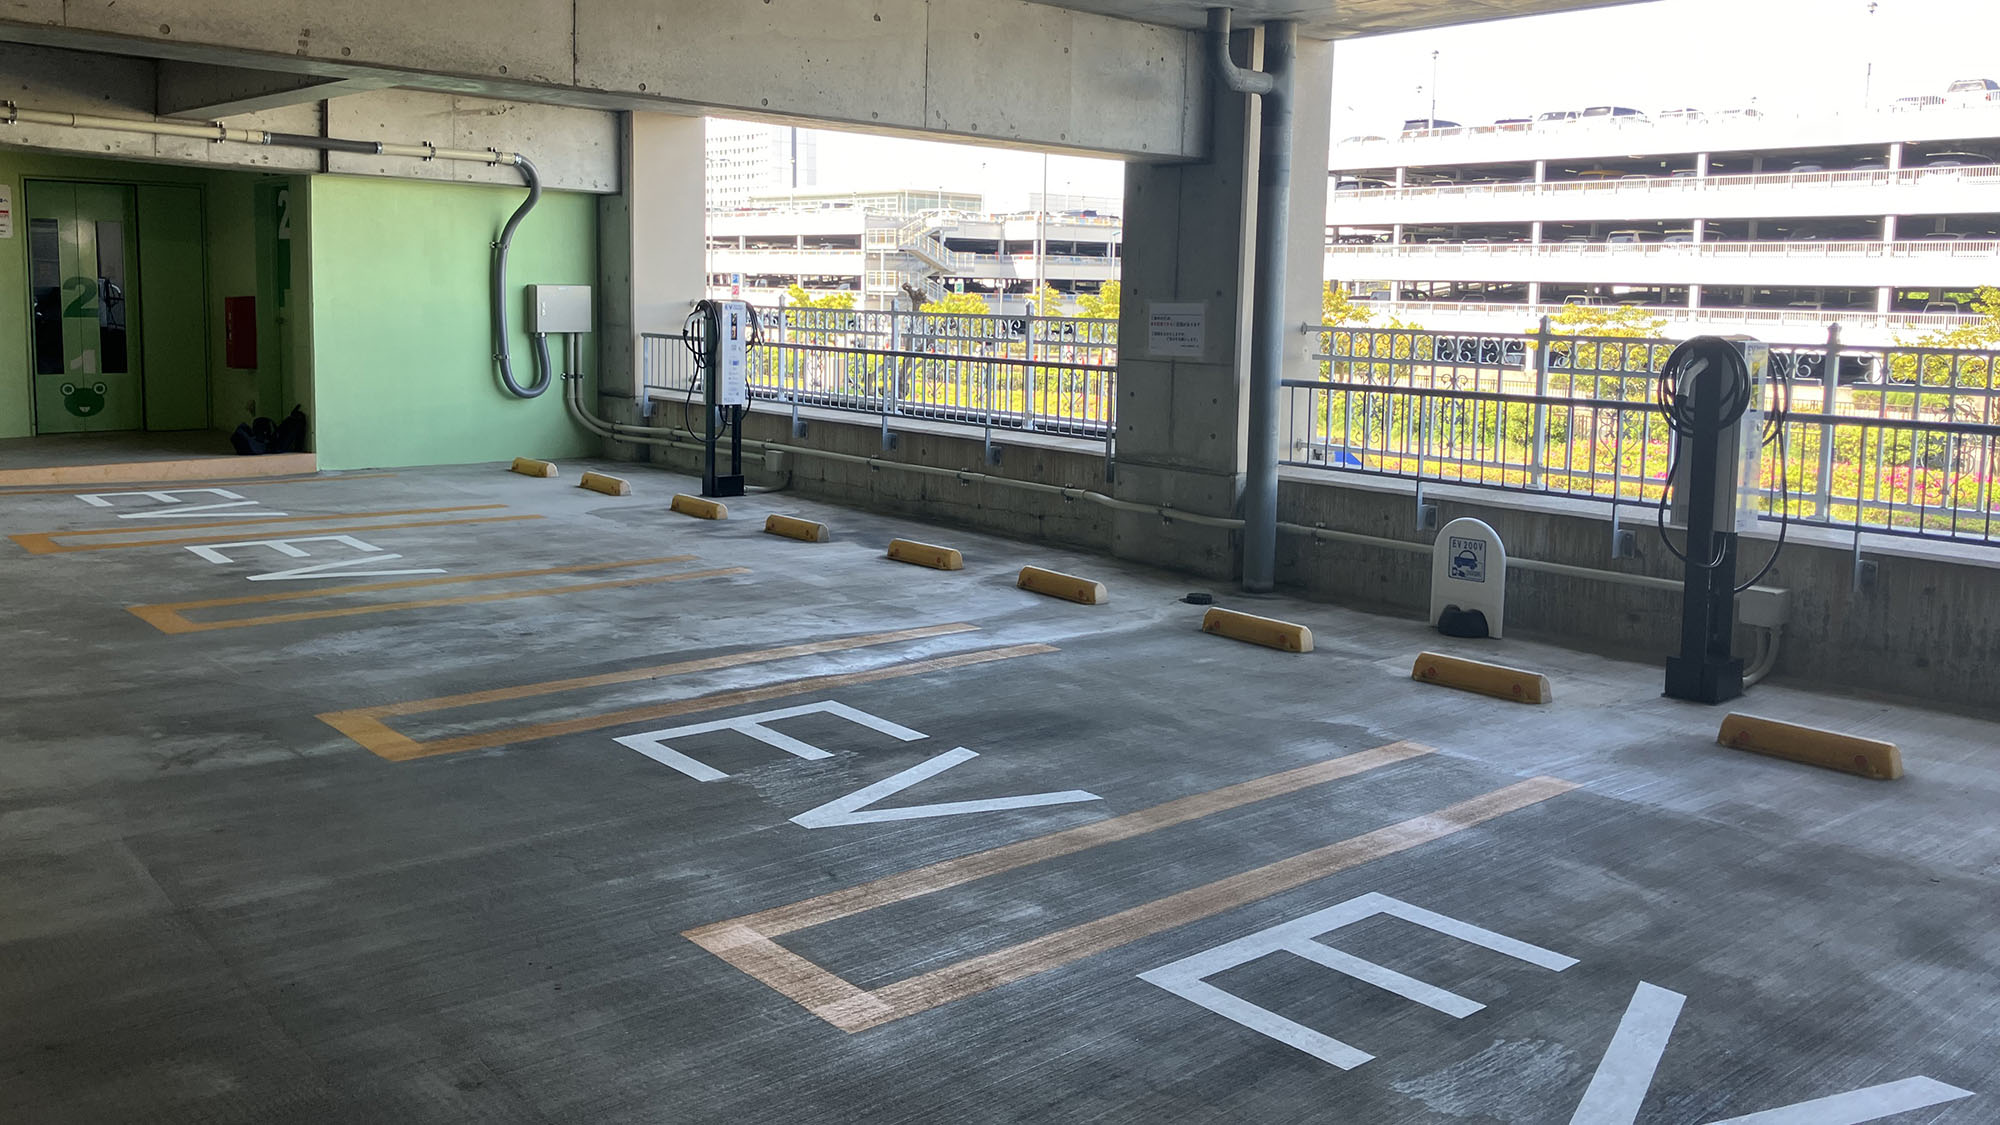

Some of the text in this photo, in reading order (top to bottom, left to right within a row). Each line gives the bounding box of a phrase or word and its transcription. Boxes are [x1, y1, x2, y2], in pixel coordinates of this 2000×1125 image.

[278, 190, 291, 240] 2
[63, 276, 99, 318] 2
[74, 488, 289, 519] EV
[184, 535, 448, 582] EV
[1452, 539, 1483, 550] EV 200V
[612, 700, 1104, 830] EV
[1135, 891, 1976, 1125] EV
